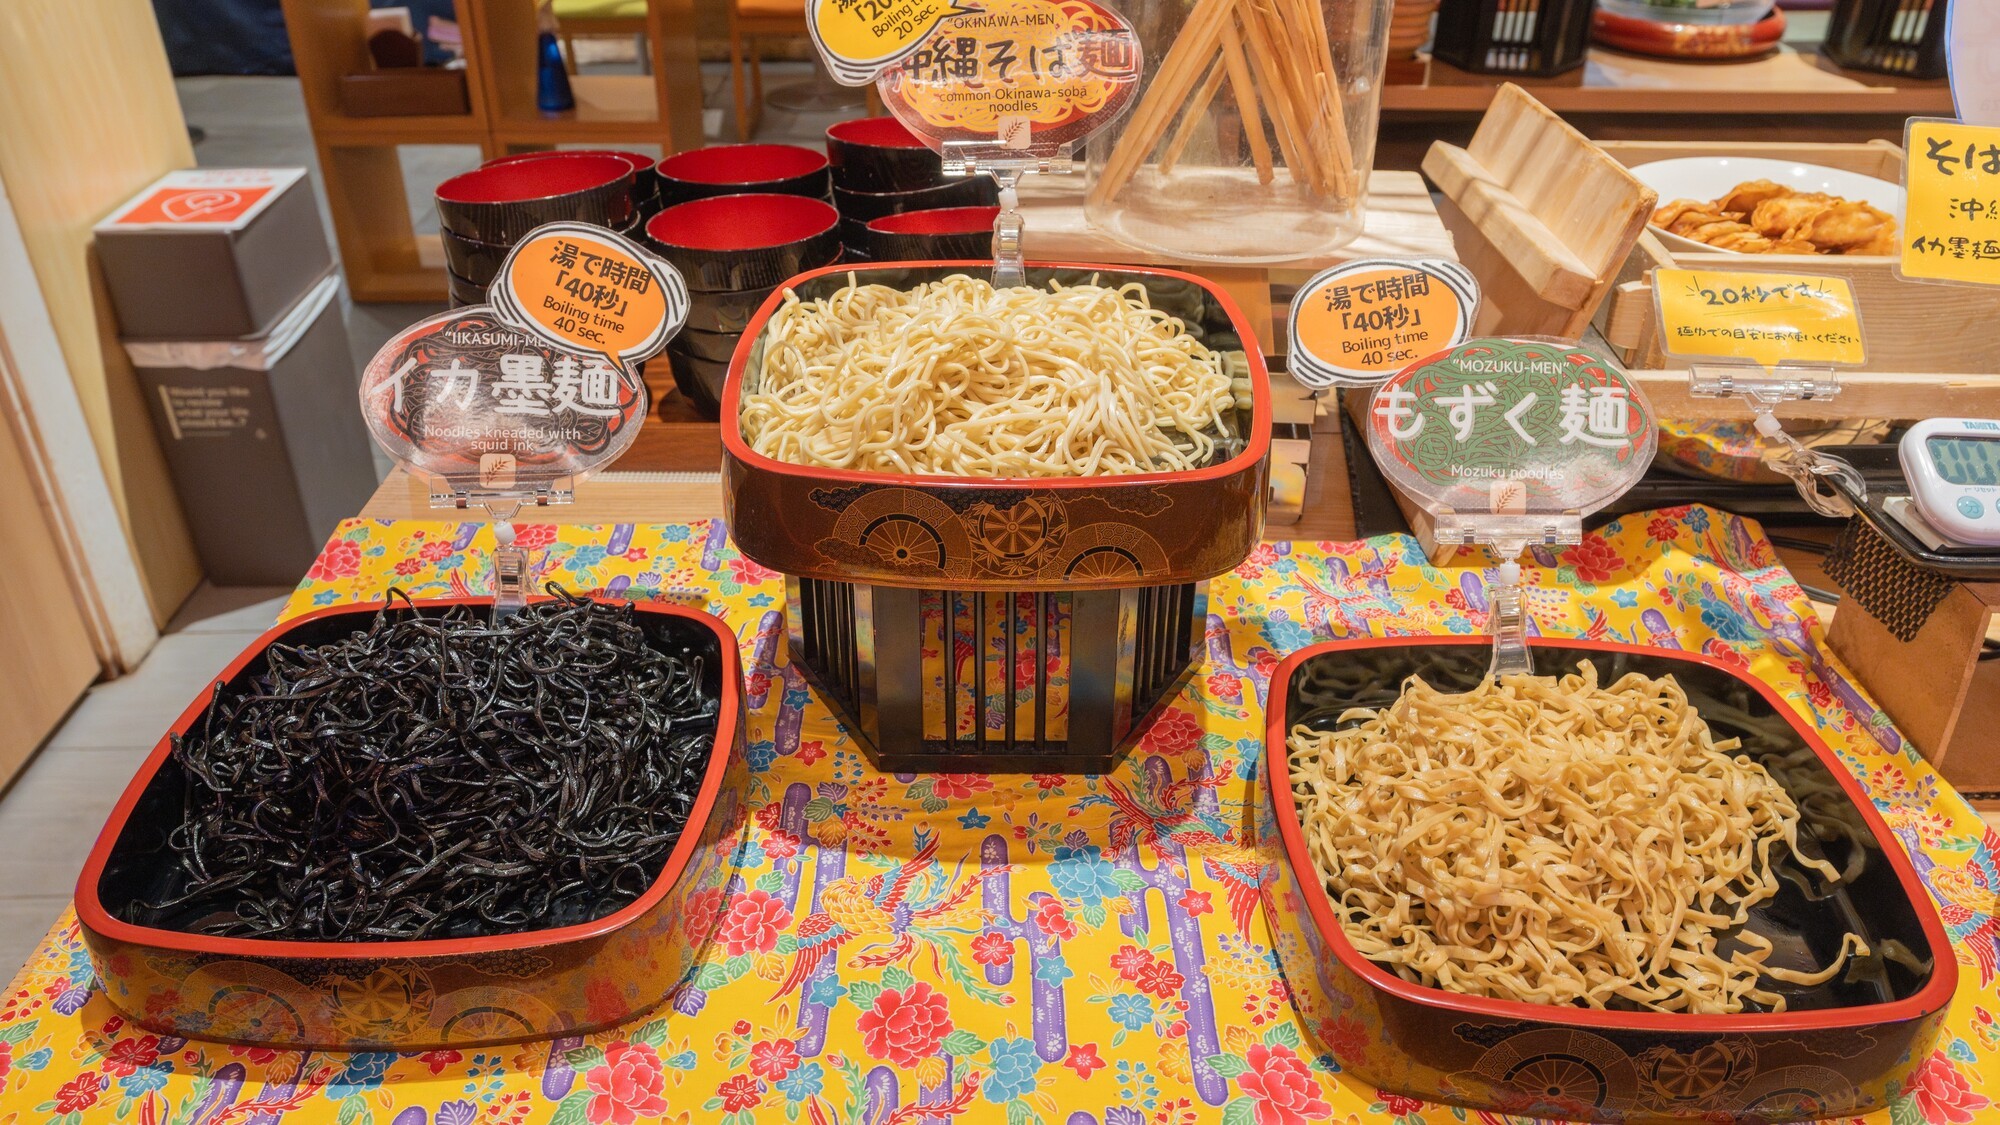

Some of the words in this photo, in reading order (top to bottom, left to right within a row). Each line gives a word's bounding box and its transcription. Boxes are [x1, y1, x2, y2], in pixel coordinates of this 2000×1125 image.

[872, 5, 913, 38] Boiling
[894, 22, 913, 40] 20
[916, 4, 939, 25] sec.
[939, 90, 991, 102] common
[995, 85, 1087, 100] Okinawa-soba
[989, 101, 1038, 113] noodles
[549, 239, 652, 295] 湯で時間
[555, 271, 628, 318] 「40秒」
[1325, 273, 1430, 312] 湯で時間
[543, 295, 590, 325] Boiling
[593, 311, 625, 334] time
[1341, 303, 1421, 332] 「40秒」
[553, 316, 576, 334] 40
[577, 325, 606, 345] sec.
[1342, 336, 1391, 355] Boiling
[1394, 329, 1429, 347] time
[1361, 351, 1383, 366] 40
[1387, 347, 1418, 363] sec.
[369, 354, 621, 417] イカ墨麺
[1374, 381, 1630, 447] もずく麺
[424, 425, 481, 438] Noodles
[485, 426, 544, 439] kneaded
[549, 427, 581, 440] with
[471, 438, 509, 452] squid
[513, 439, 534, 451] ink
[1451, 464, 1506, 478] Mozuku
[1511, 467, 1564, 480] noodles
